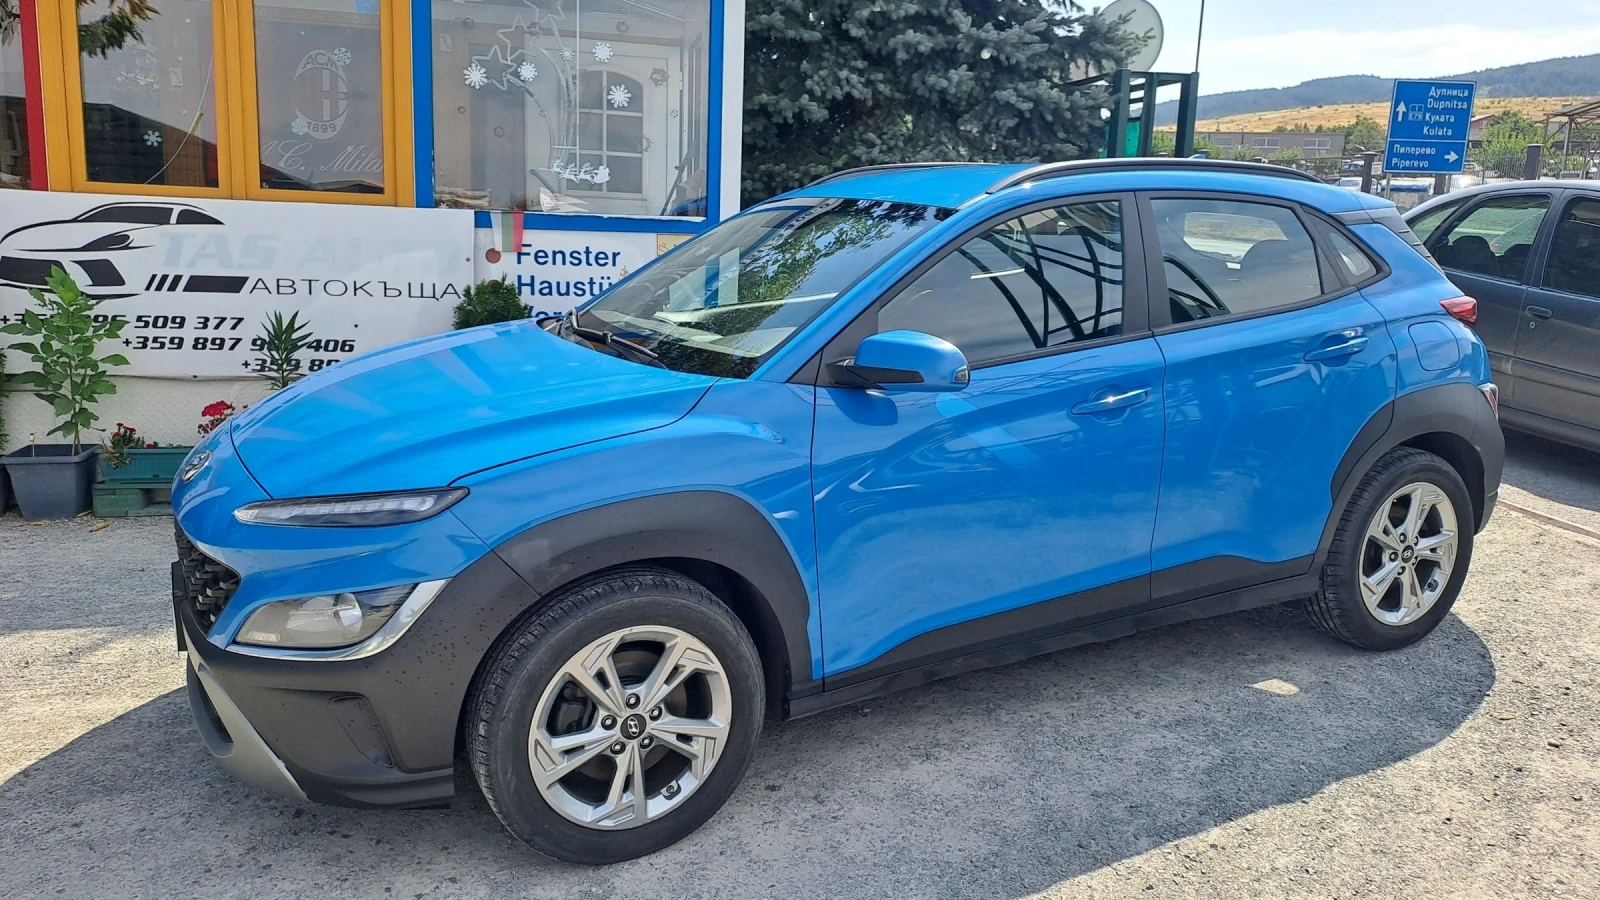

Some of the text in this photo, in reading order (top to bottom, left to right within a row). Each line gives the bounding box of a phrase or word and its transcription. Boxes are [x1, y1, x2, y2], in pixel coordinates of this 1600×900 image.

[303, 52, 339, 71] ACM
[1429, 86, 1469, 98] Дупница
[1427, 99, 1468, 110] Dupnitsa
[1425, 112, 1455, 124] Кулата
[306, 121, 337, 133] 1899
[1423, 126, 1452, 136] Kulata
[1393, 144, 1436, 156] Пиперево
[1391, 158, 1429, 169] Piperevo
[160, 231, 280, 270] TAS
[516, 243, 621, 267] Fenster
[249, 277, 463, 302] АВТОКЪЩА
[133, 315, 187, 329] 509
[193, 316, 245, 330] 377
[122, 336, 185, 350] +359
[192, 337, 243, 351] 897
[306, 339, 356, 352] 406
